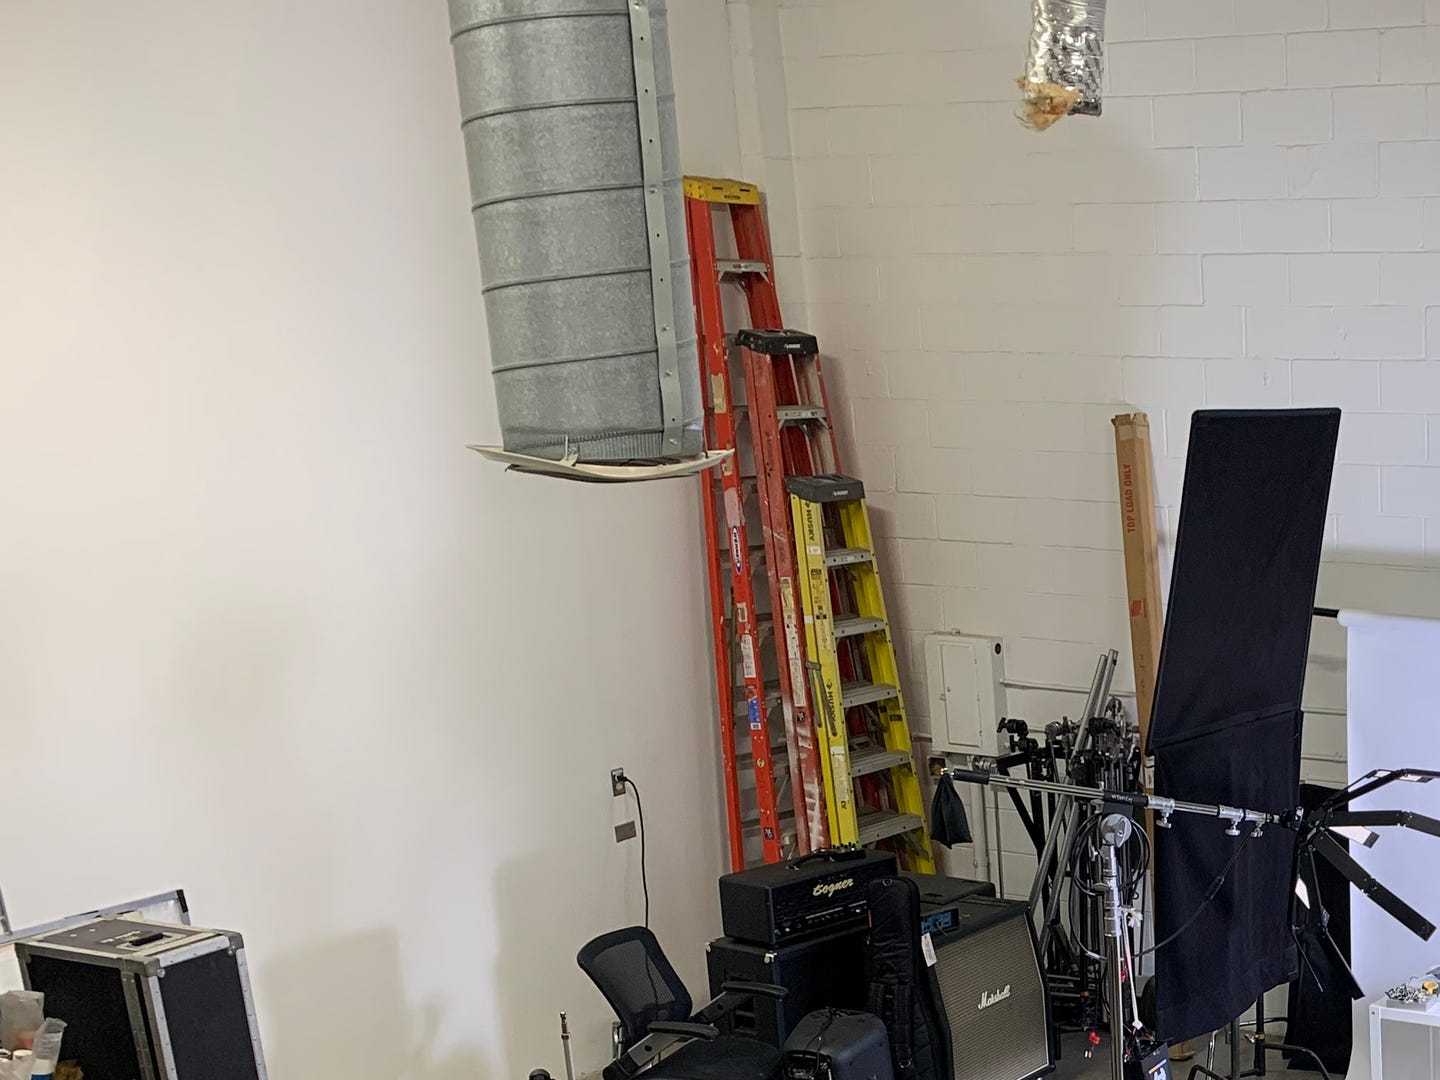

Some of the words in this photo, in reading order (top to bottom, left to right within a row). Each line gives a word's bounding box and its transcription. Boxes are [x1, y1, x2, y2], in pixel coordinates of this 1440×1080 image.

[1123, 464, 1134, 487] ONLY
[1124, 490, 1135, 510] LOAD
[806, 509, 816, 541] HUSKY
[1127, 520, 1136, 533] TOP
[812, 878, 855, 897] Bogner
[977, 984, 1011, 1010] Marshall
